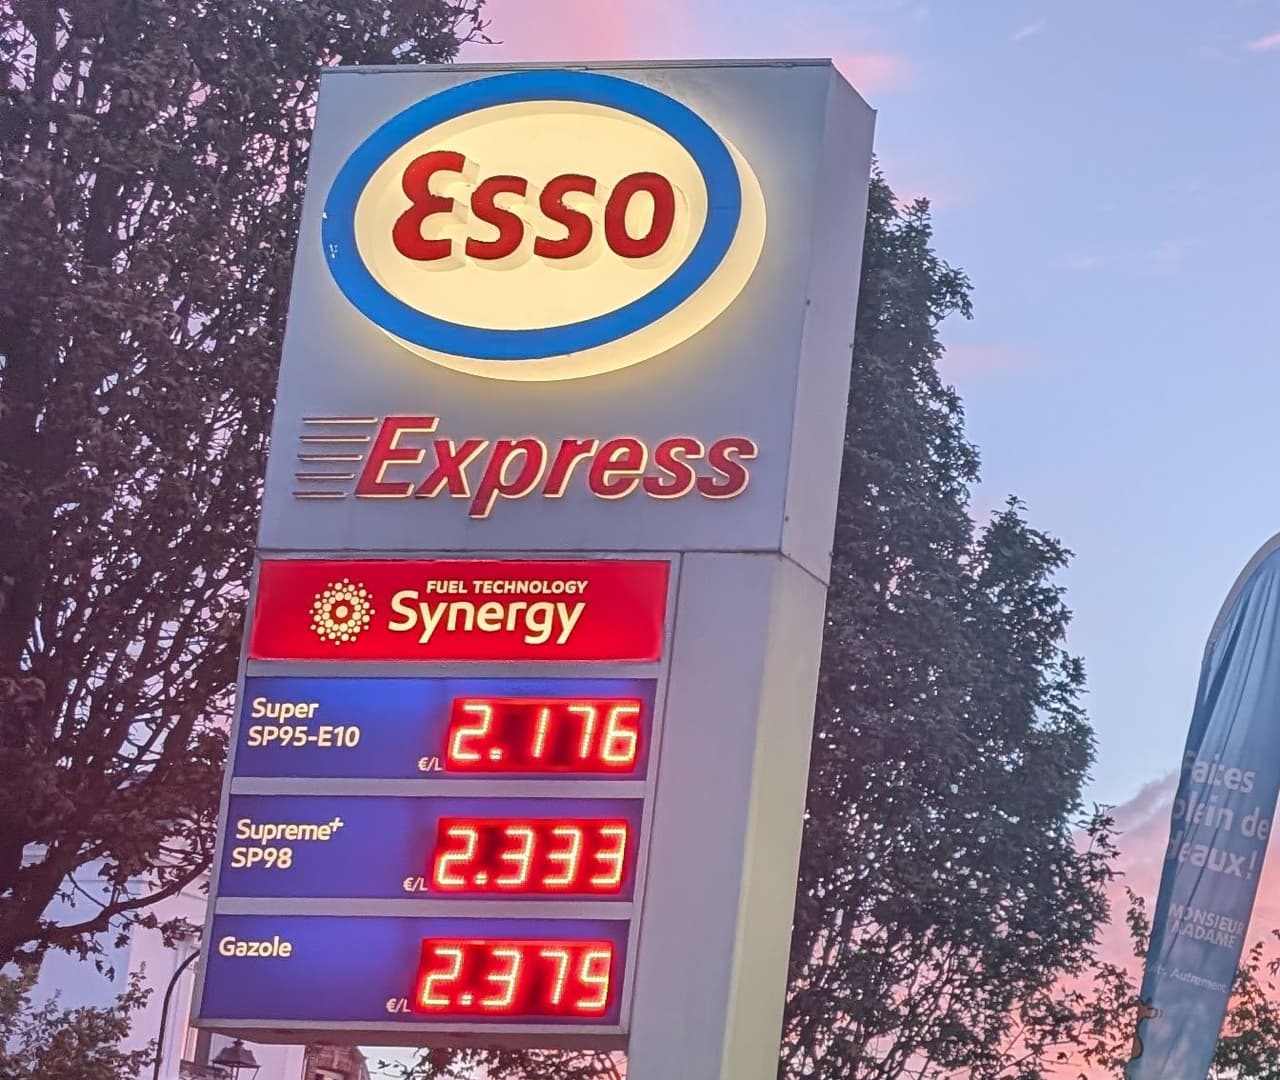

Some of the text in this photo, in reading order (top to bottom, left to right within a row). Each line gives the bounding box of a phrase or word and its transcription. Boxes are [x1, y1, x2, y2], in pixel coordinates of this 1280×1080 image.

[355, 416, 758, 518] Express
[426, 580, 588, 594] FUEL TECHNOLOGY
[388, 590, 586, 645] Synergy
[251, 697, 319, 724] Super
[247, 725, 361, 748] SP95-E10
[451, 703, 641, 762] 2.176
[417, 757, 443, 772] €/L
[231, 847, 294, 869] SP98
[438, 827, 626, 886] 2.333
[402, 876, 428, 892] €/L
[218, 936, 292, 957] Gazole
[385, 998, 411, 1013] €/L
